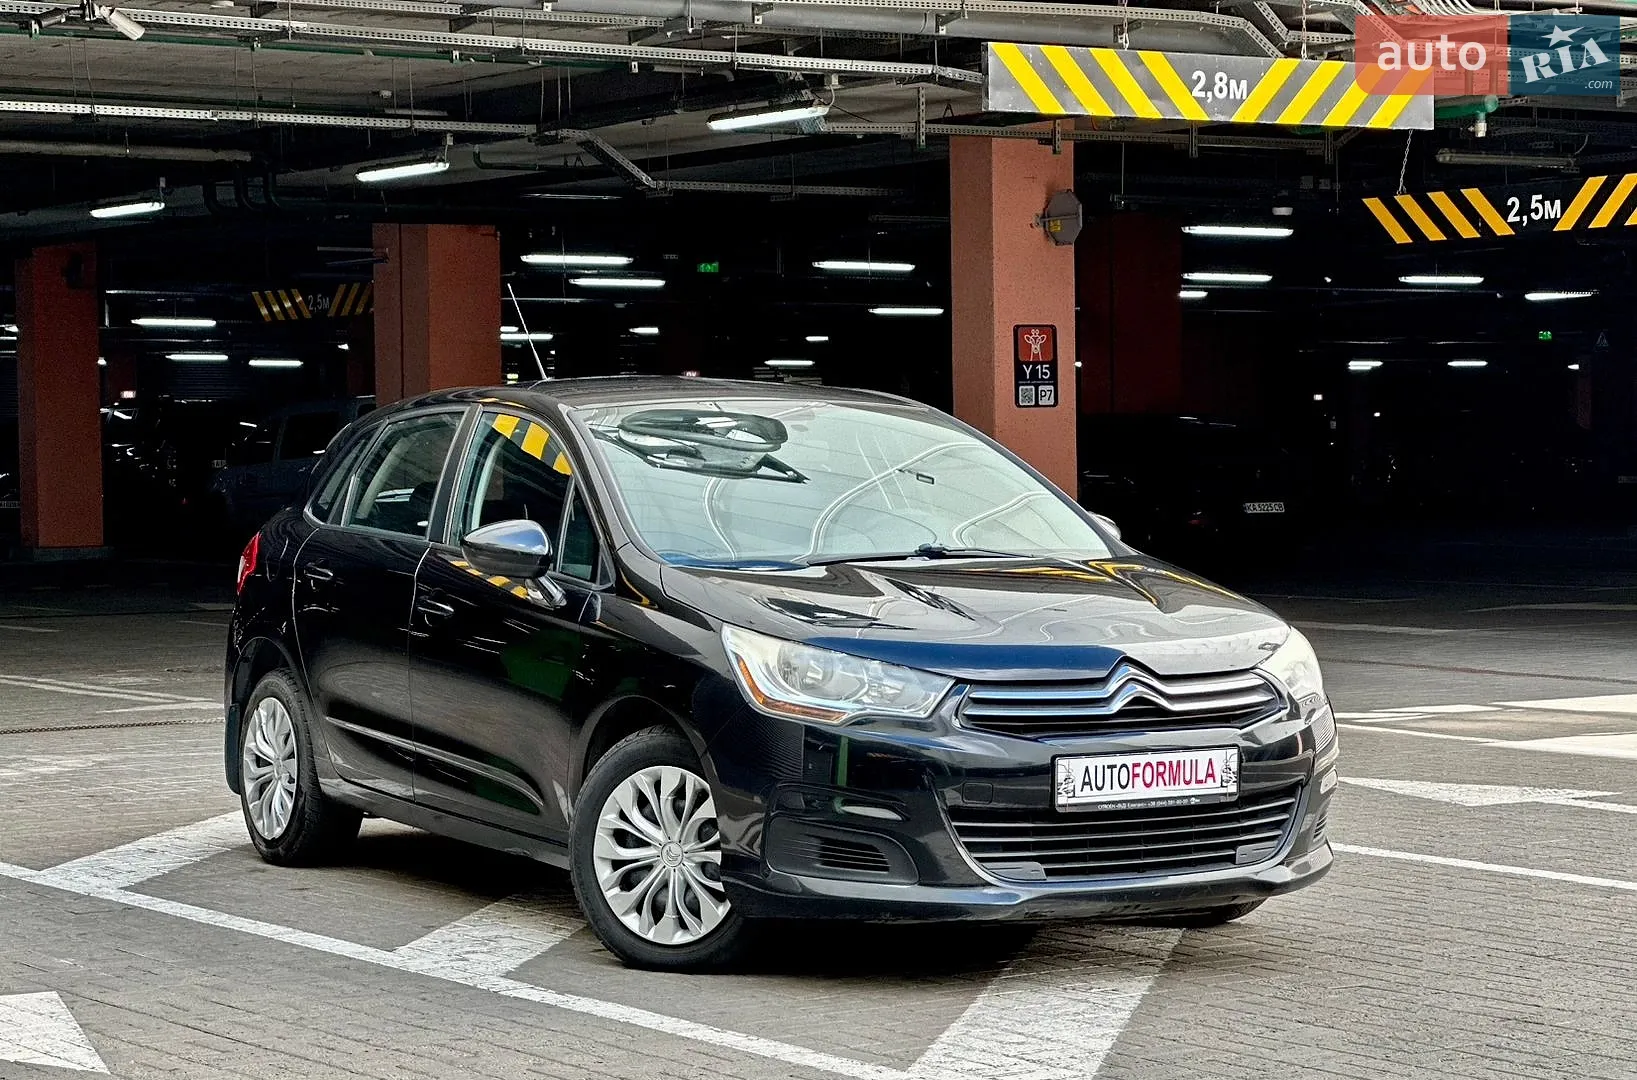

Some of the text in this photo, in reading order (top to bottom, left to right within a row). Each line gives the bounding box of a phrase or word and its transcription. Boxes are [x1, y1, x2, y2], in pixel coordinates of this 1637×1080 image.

[1191, 70, 1248, 104] 2,8м
[1506, 194, 1561, 227] 2,5м
[1022, 364, 1051, 380] Y 15
[1039, 389, 1053, 401] P7
[1080, 758, 1216, 792] AUTOFORMULA
